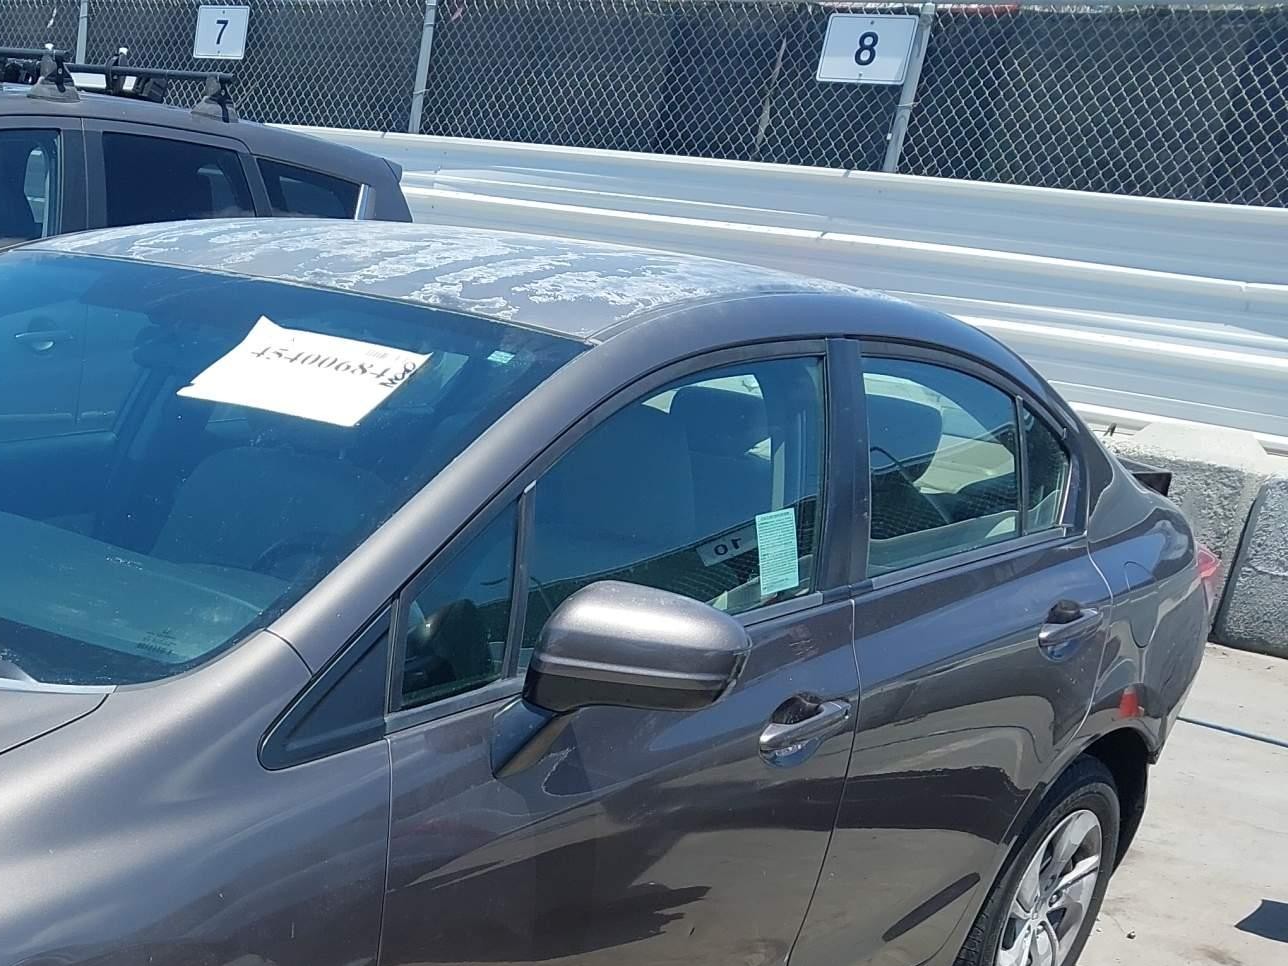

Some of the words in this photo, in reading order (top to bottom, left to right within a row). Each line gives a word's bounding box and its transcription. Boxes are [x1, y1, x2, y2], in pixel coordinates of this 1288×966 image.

[215, 19, 230, 46] 7
[854, 31, 879, 66] 8
[250, 346, 392, 379] 45400684
